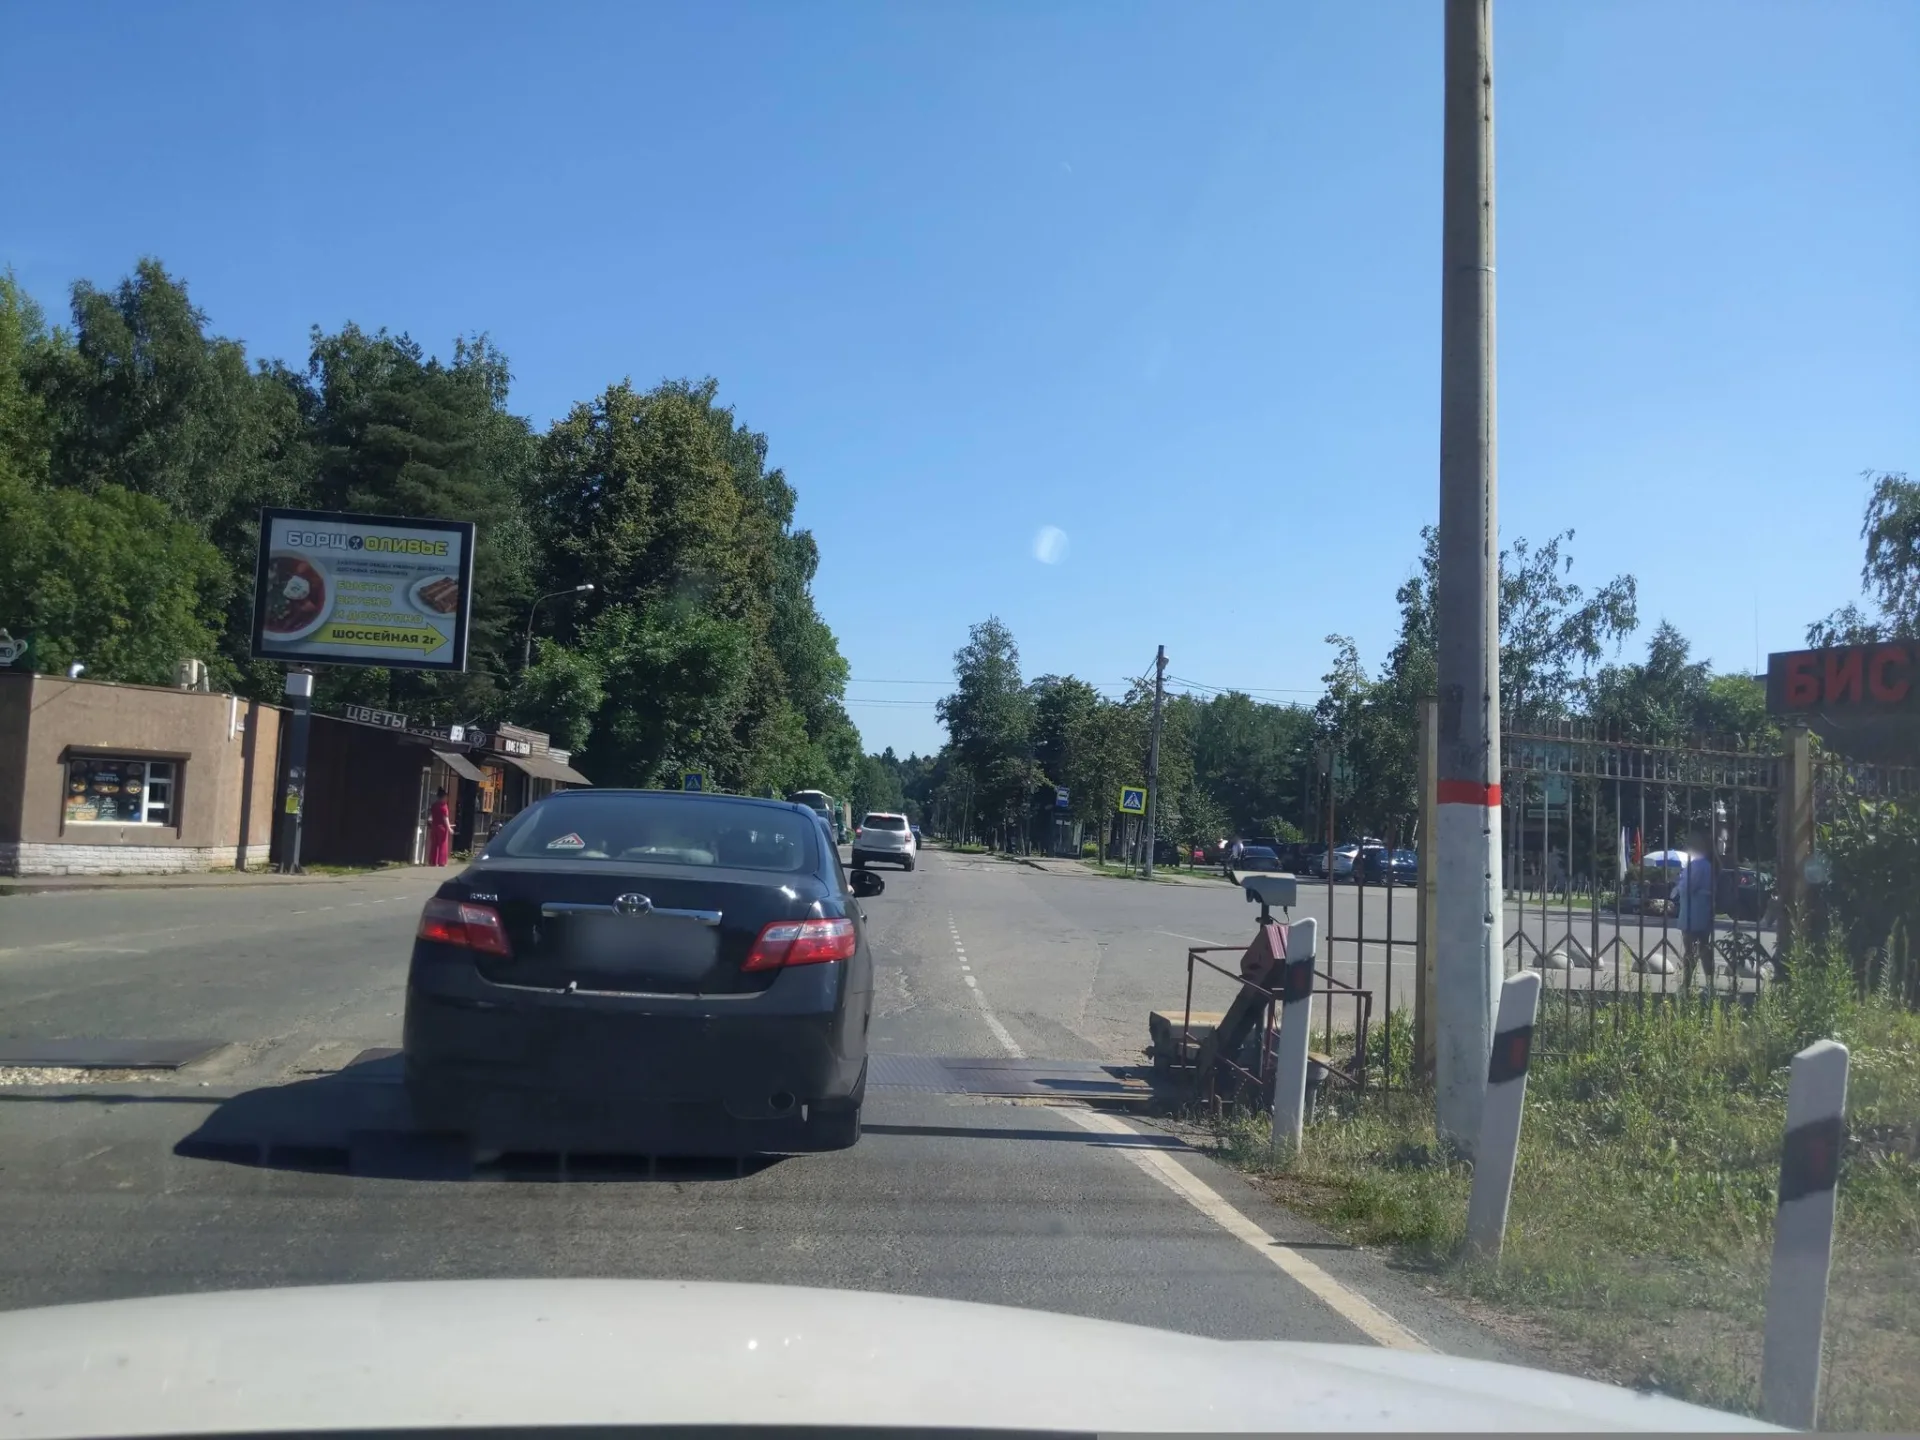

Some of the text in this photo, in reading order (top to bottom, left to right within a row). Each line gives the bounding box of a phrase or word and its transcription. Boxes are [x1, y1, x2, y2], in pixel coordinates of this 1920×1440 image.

[287, 530, 449, 556] БОРЩ ОЛИВЬЕ
[337, 580, 394, 593] БЫСТРО
[337, 595, 392, 608] ВКУСНО
[347, 611, 424, 625] ДОСТУПНО
[332, 628, 437, 646] ШОССЕЙНАЯ 2г
[1786, 647, 1920, 706] БИС
[346, 707, 407, 728] ЦВЕТЫ
